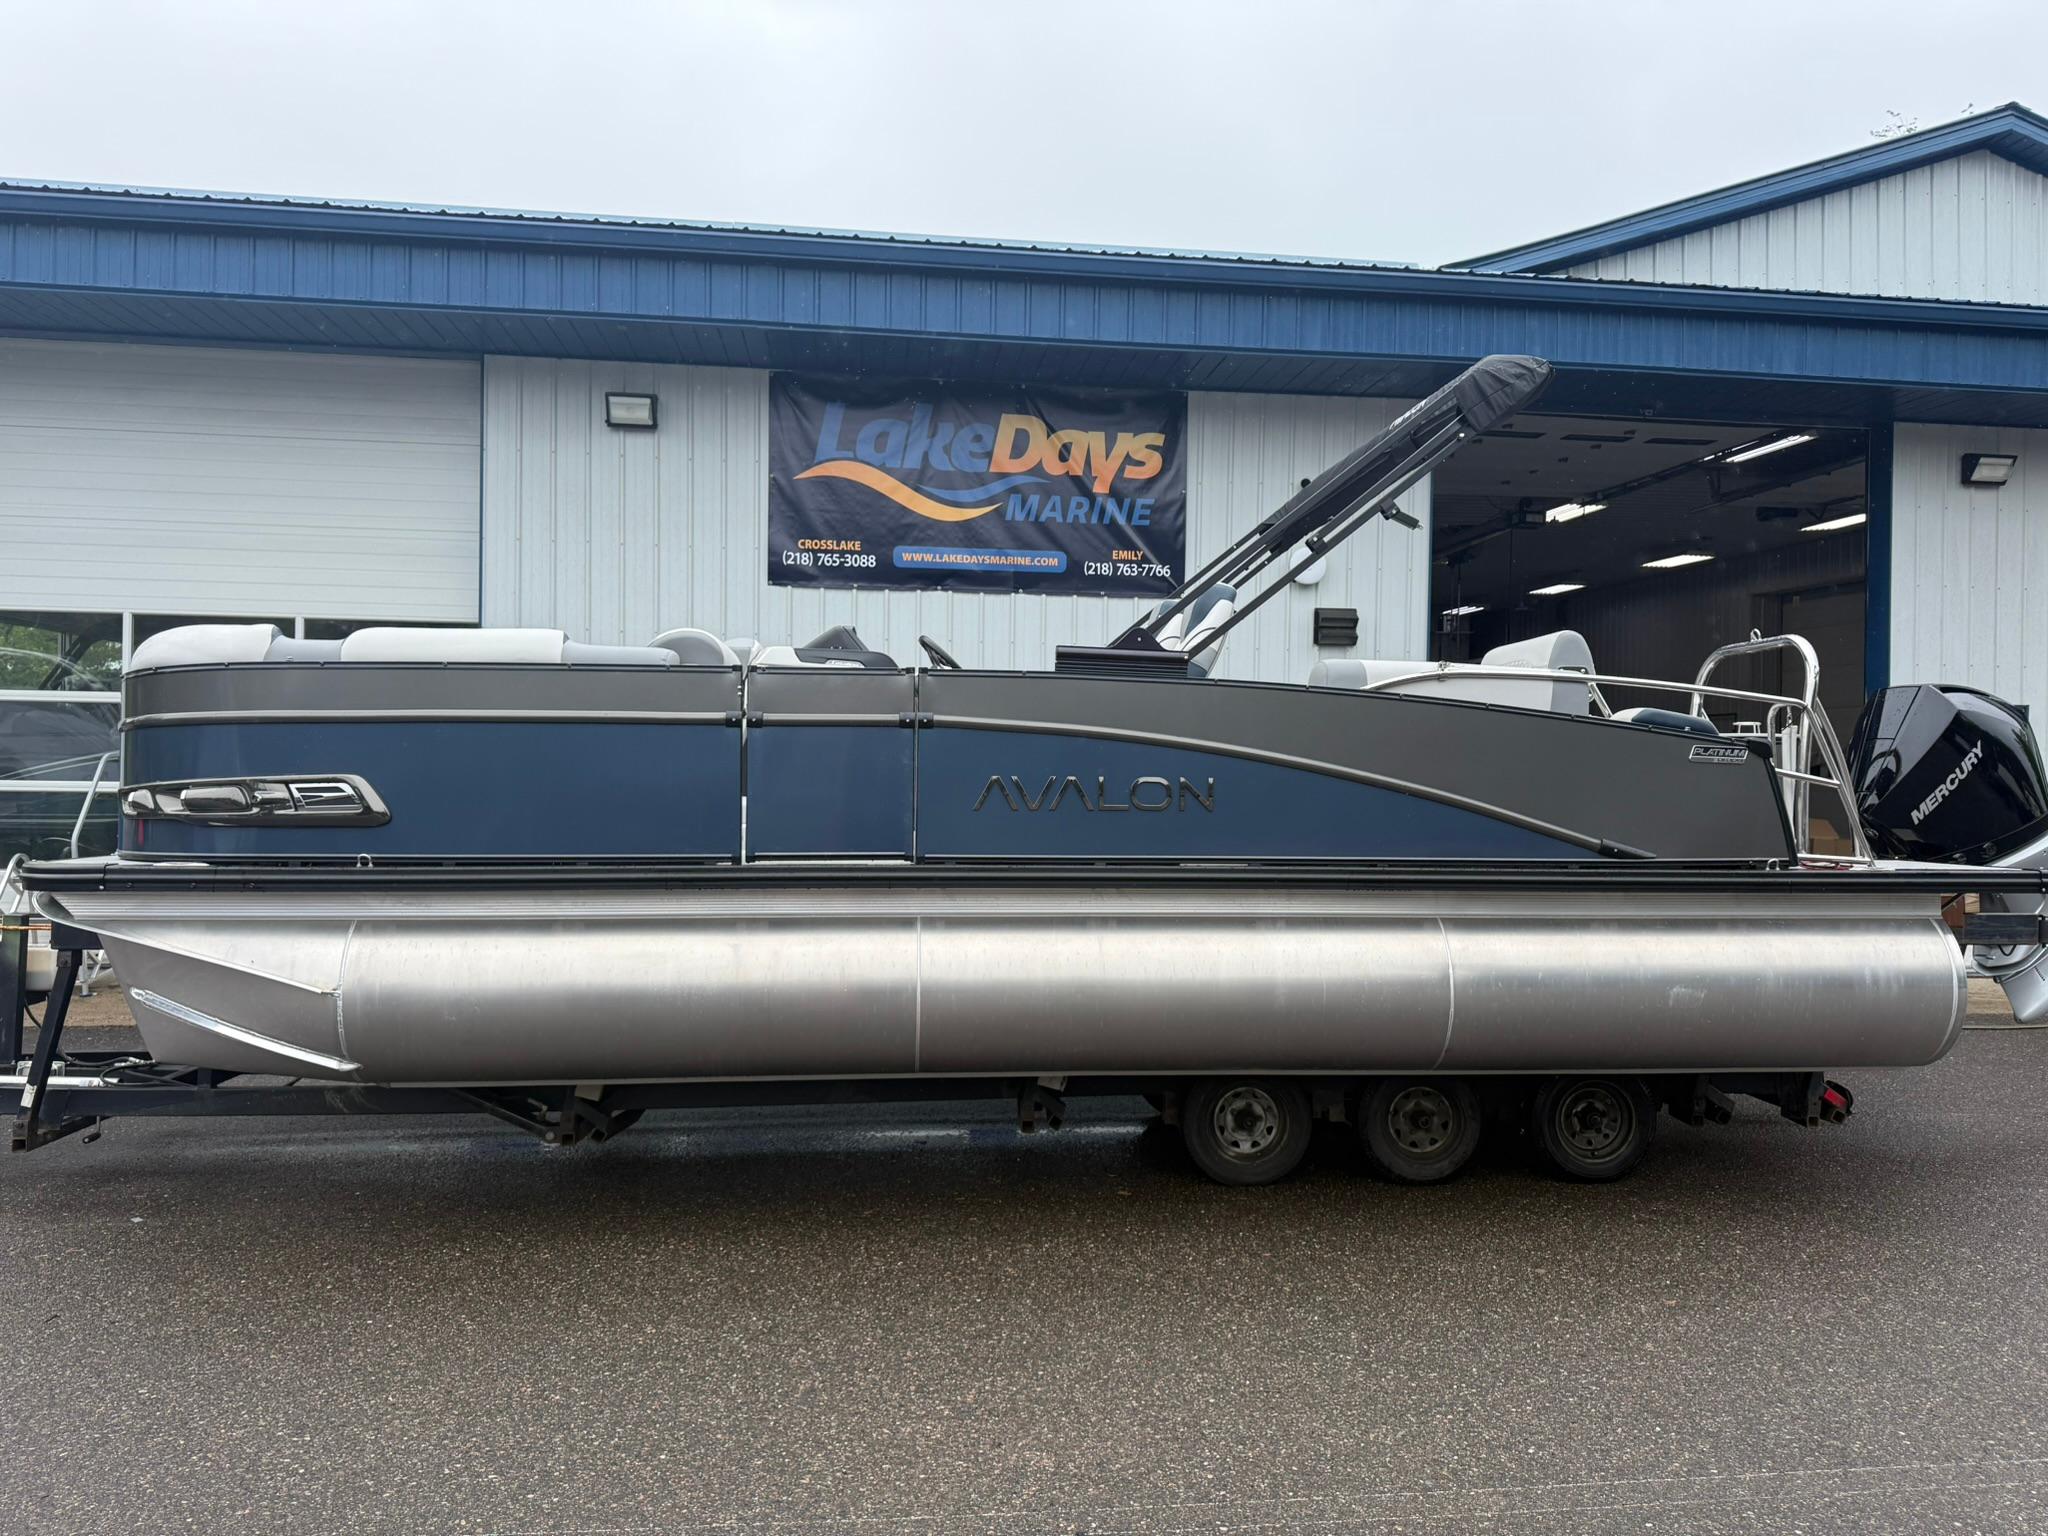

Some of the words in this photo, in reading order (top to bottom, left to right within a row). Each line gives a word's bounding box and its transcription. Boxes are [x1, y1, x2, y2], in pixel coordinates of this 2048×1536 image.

[815, 401, 1165, 494] LakeDays
[1005, 493, 1155, 526] MARINE
[798, 538, 862, 551] CROSSLAKE
[782, 550, 814, 567] (218)
[817, 552, 877, 568] 765-3088
[901, 551, 1059, 567] WWW.LAKEDAYSMARINE.COM
[1112, 549, 1144, 561] EMILY
[1084, 560, 1114, 576] (218)
[1116, 562, 1171, 578] 763-7766
[1693, 747, 1745, 757] PLATINUM
[1910, 739, 1984, 826] MERCURY
[972, 775, 1217, 812] AVALON
